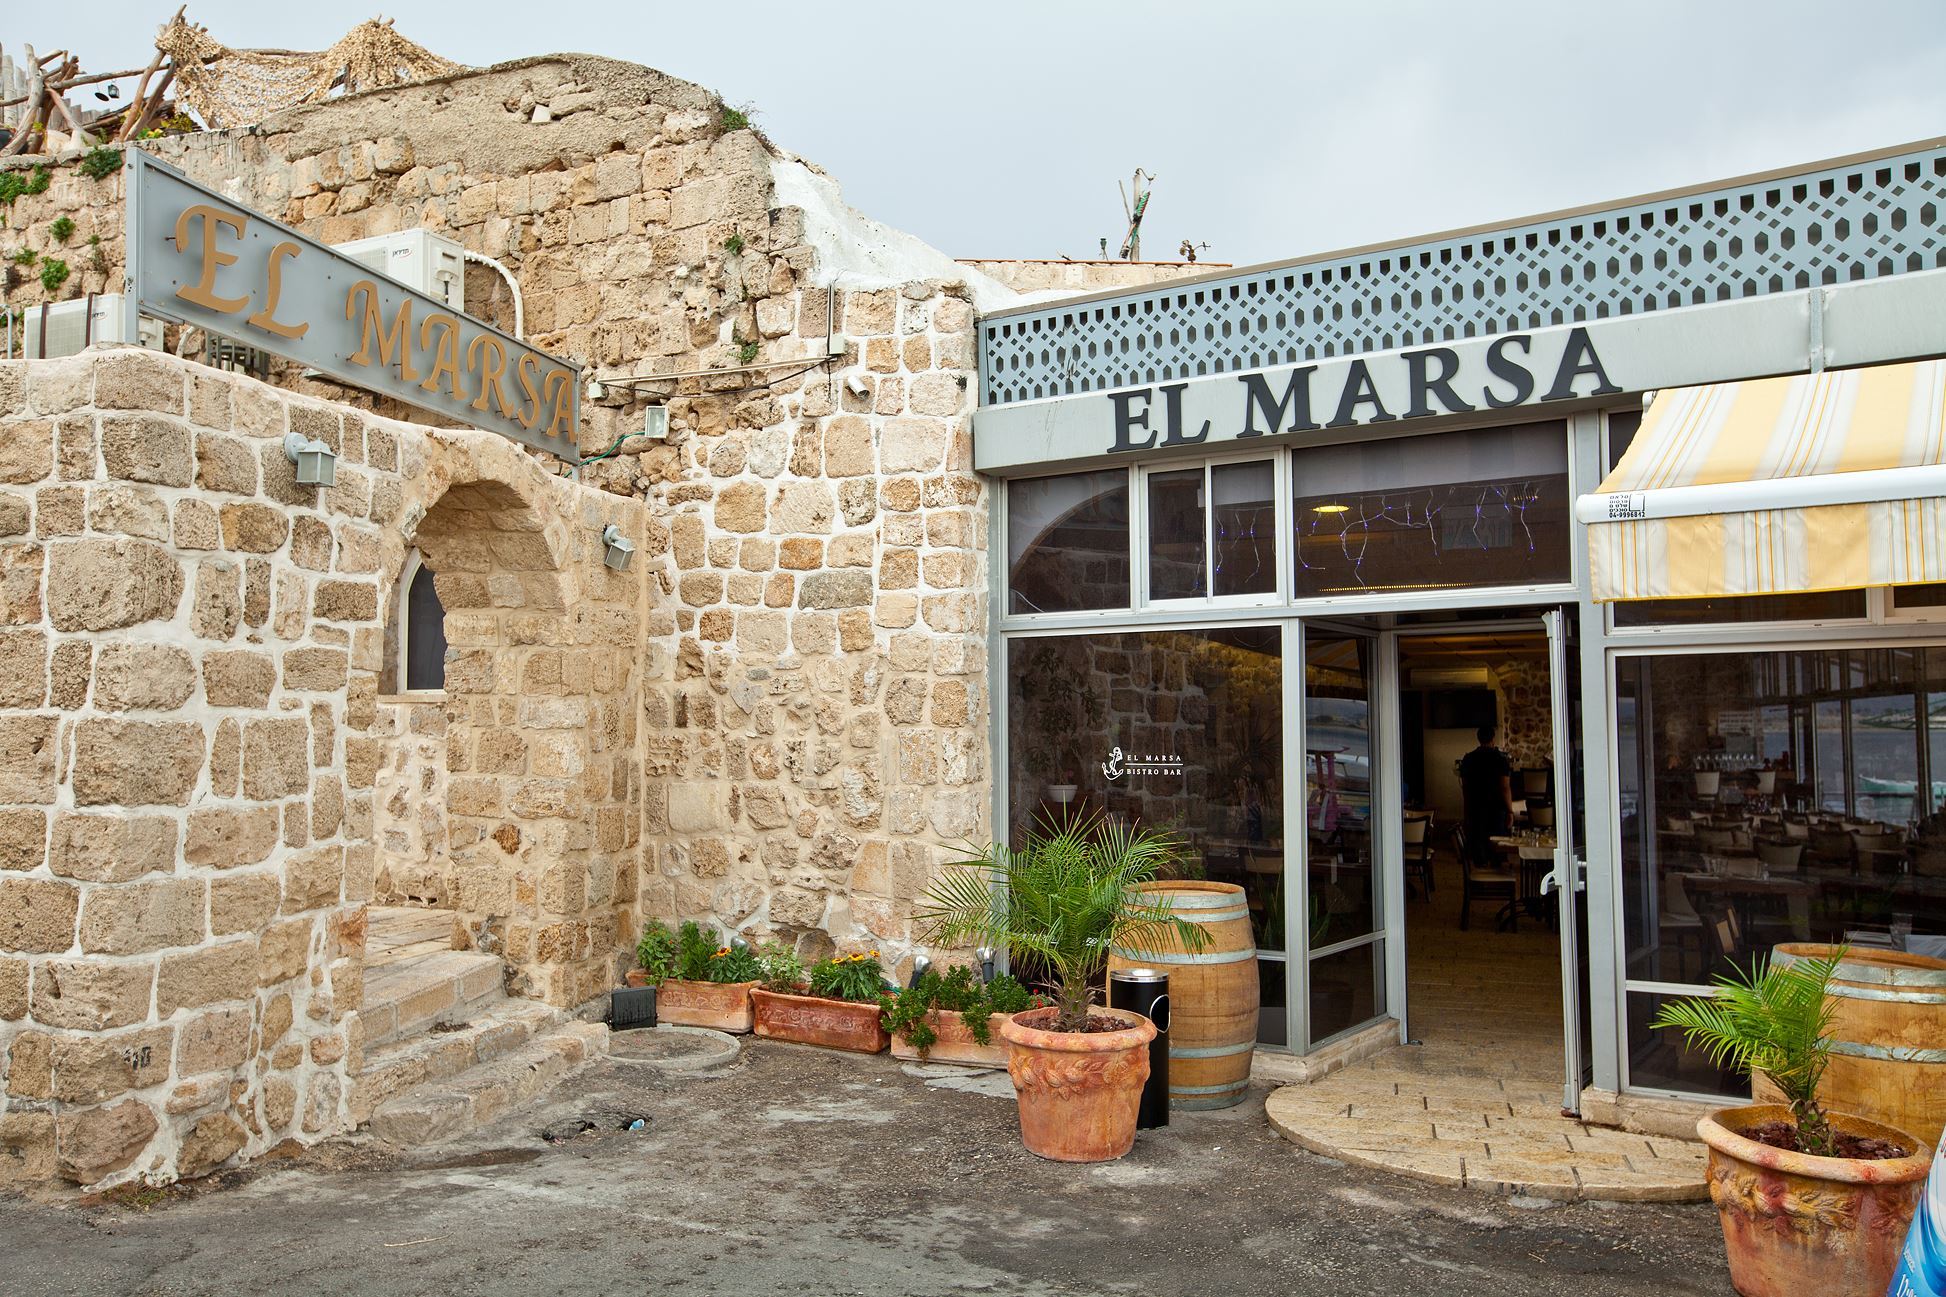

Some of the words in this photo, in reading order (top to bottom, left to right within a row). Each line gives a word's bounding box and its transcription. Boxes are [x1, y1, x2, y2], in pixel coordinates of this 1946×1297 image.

[175, 204, 310, 340] EL
[345, 279, 578, 444] MARSA
[1106, 382, 1211, 455] EL
[1236, 326, 1624, 439] MARSA
